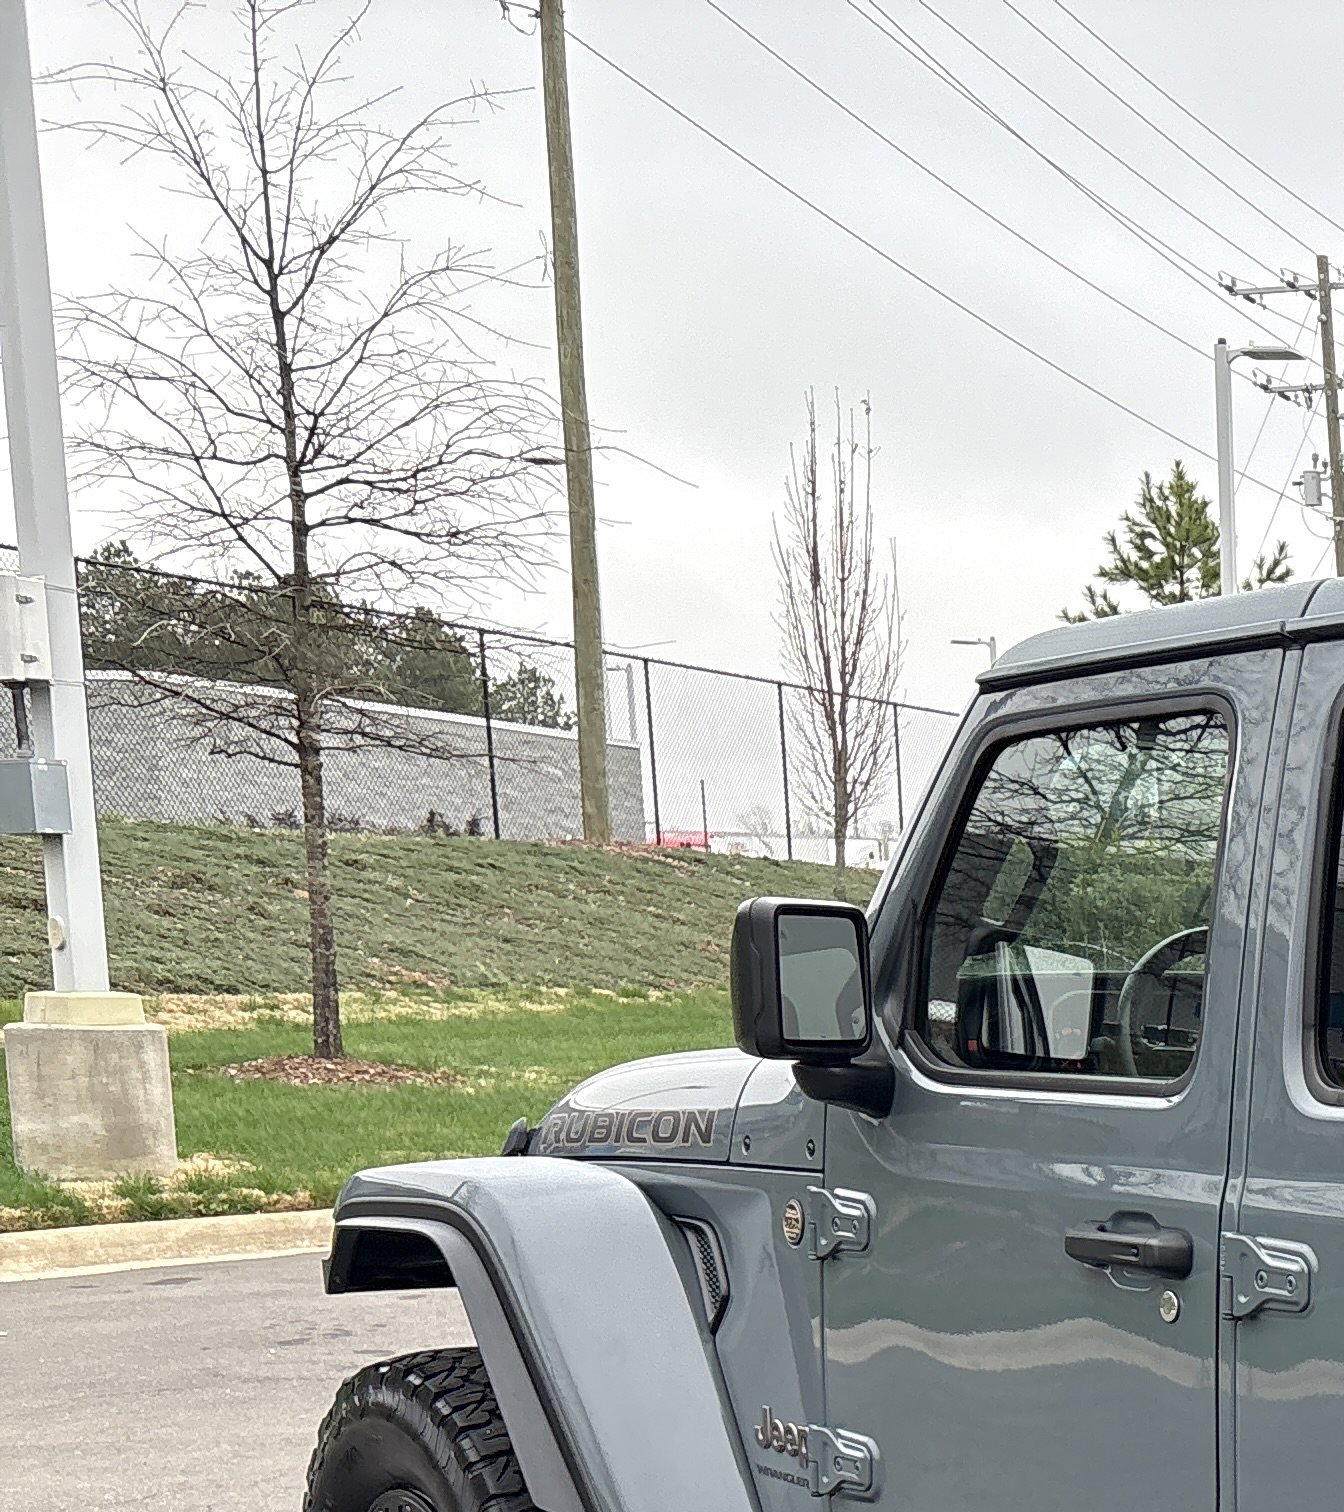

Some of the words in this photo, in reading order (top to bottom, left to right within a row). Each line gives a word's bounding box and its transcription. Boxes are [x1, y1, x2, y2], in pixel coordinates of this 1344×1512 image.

[541, 1108, 718, 1148] RUBICON
[754, 1404, 810, 1469] Jeep
[756, 1464, 811, 1489] WRANGLER
